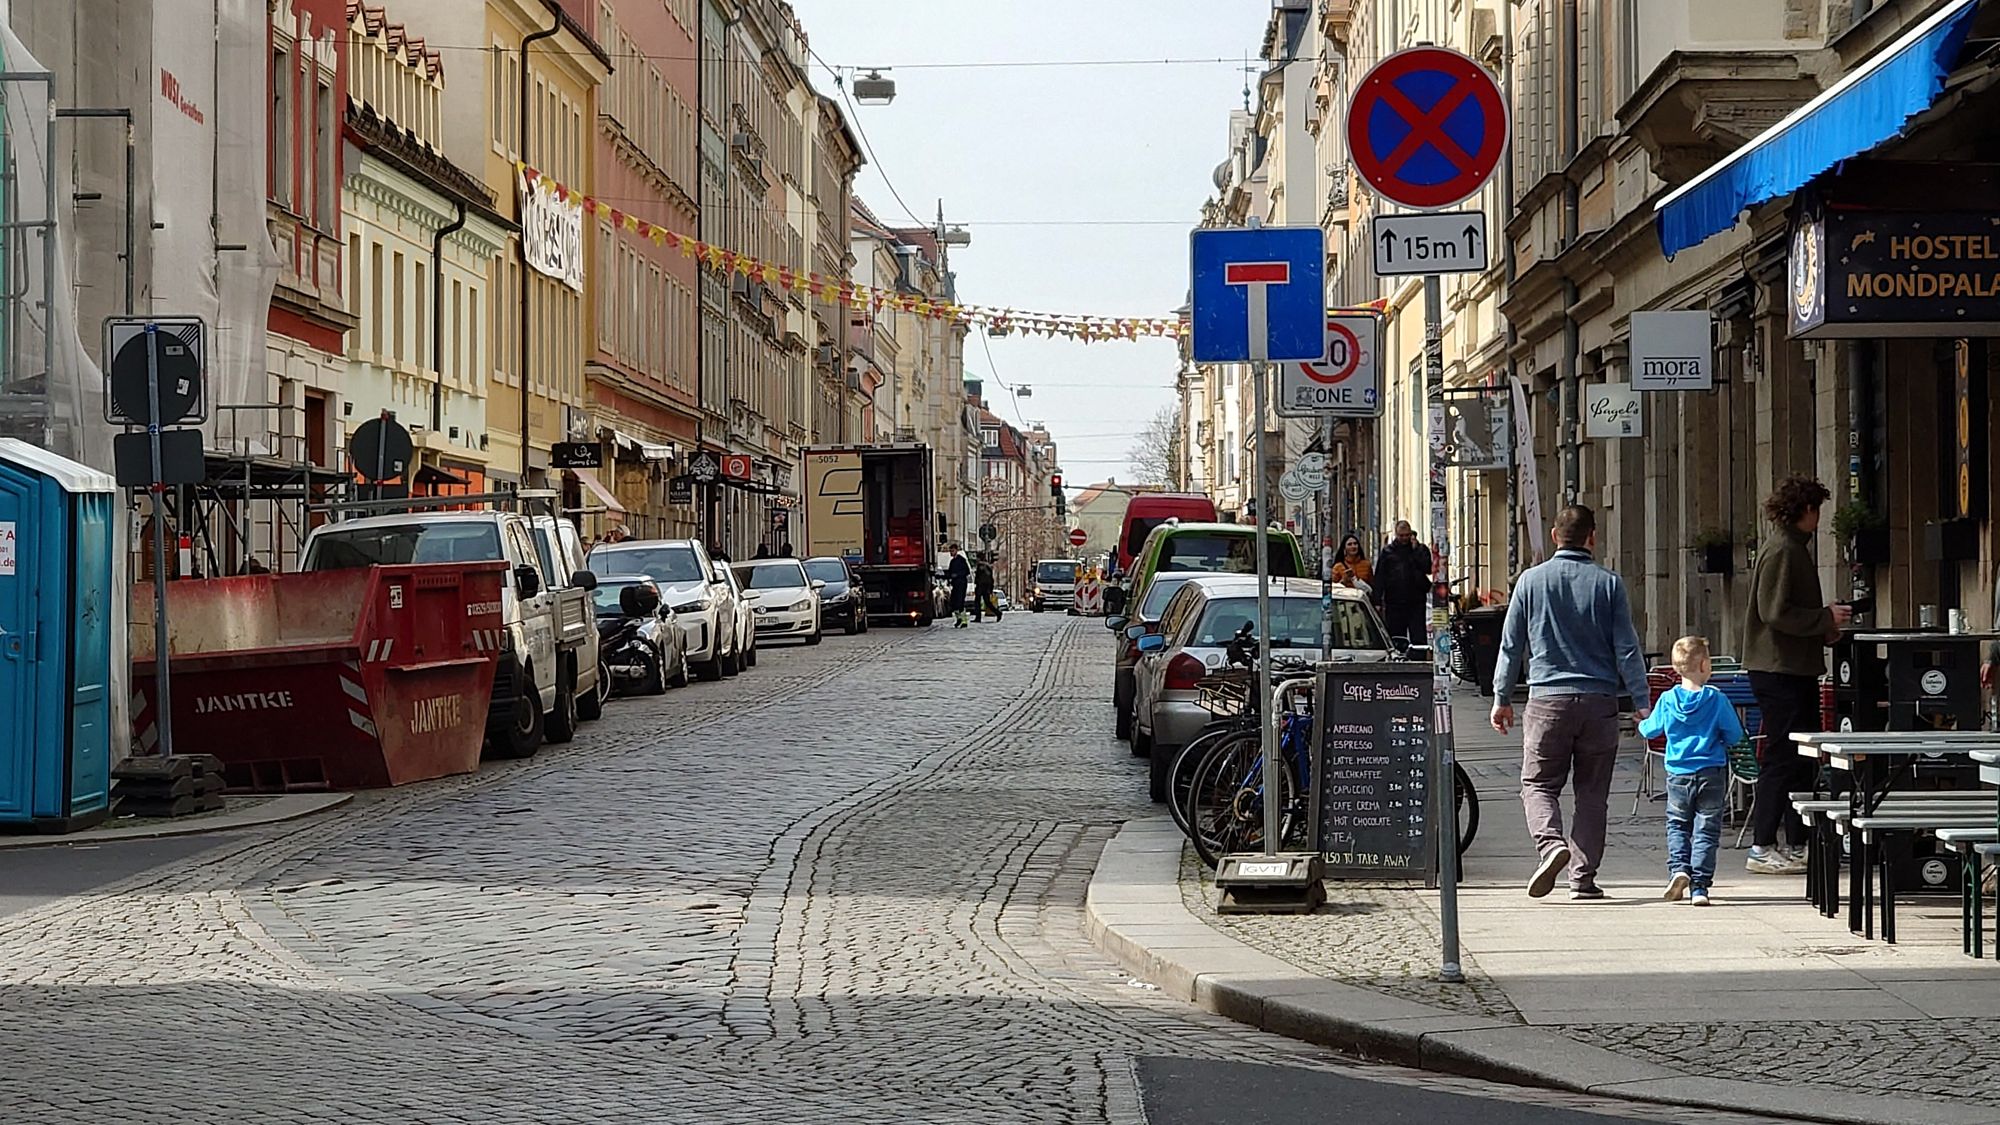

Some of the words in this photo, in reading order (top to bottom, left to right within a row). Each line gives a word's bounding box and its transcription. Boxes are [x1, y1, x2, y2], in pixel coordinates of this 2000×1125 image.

[1404, 236, 1457, 260] 15m
[1891, 235, 1999, 260] HOSTEL
[1312, 340, 1347, 367] 0
[1642, 360, 1701, 376] mora
[1309, 387, 1353, 404] ONE
[818, 455, 839, 464] 5052
[1343, 682, 1372, 701] Coffee
[195, 690, 294, 713] JANTKE
[410, 694, 461, 734] JANTKE
[1333, 724, 1373, 734] AMERICANO
[1333, 740, 1373, 750] ESPRESSO
[1333, 756, 1354, 765] LATTE
[1333, 770, 1382, 779] MILCHKAFFEE
[1334, 816, 1348, 826] HOT
[1352, 816, 1392, 826] CHOCOLATE
[1332, 831, 1353, 843] TEA
[1321, 851, 1341, 864] ALSO
[1343, 852, 1354, 865] TO
[1383, 854, 1411, 868] AWAY
